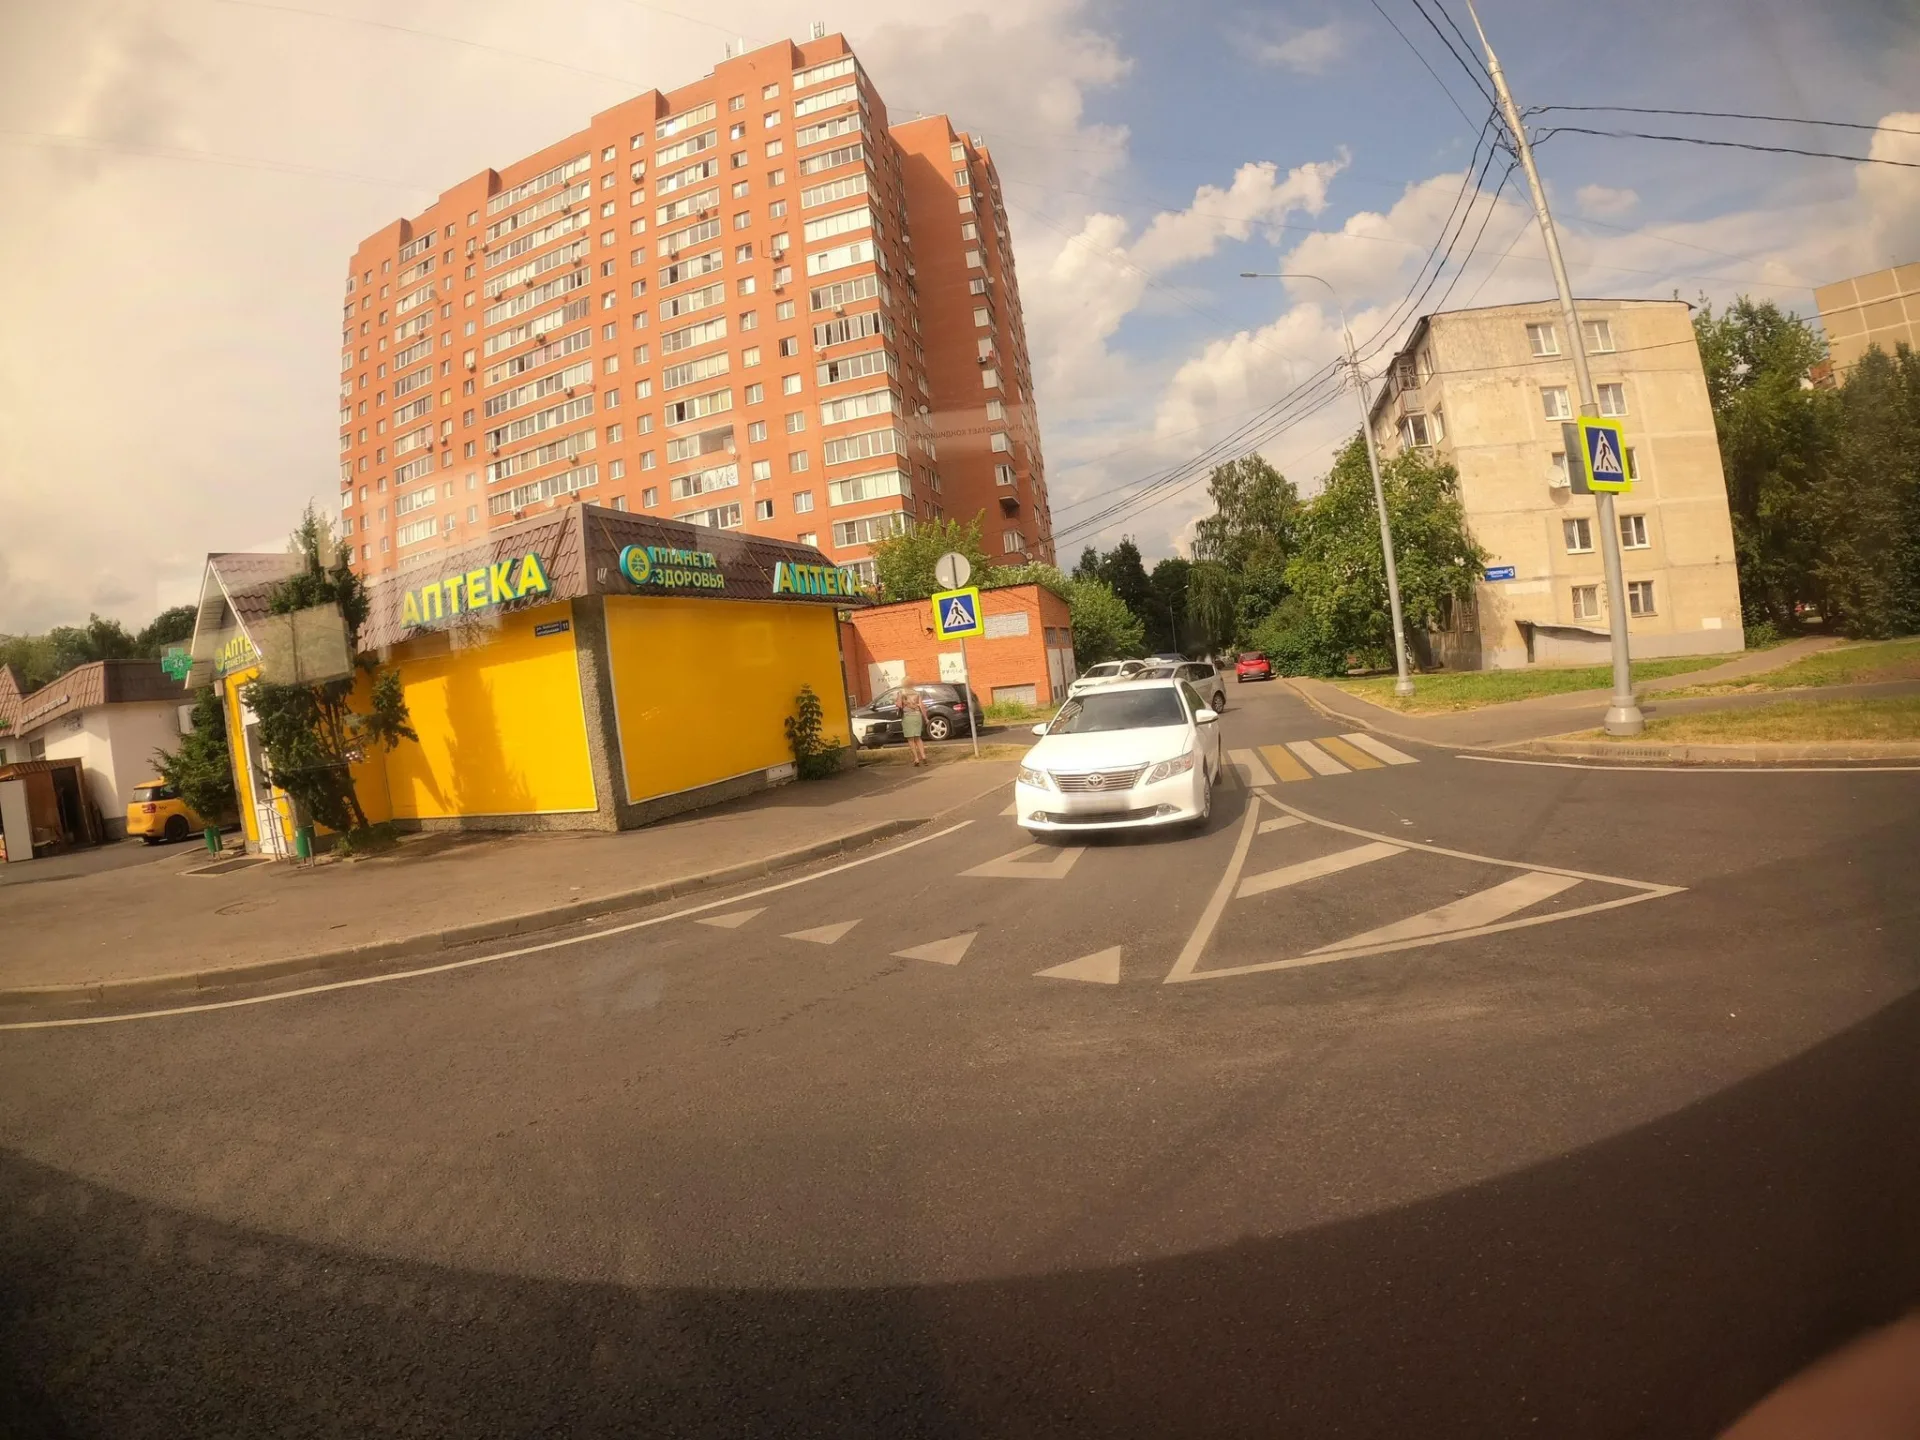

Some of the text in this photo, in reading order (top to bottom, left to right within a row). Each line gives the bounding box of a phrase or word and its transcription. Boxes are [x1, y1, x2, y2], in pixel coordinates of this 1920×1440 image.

[650, 546, 717, 568] ПЛАНЕТА
[655, 568, 725, 588] ЗДОРОВЬЯ
[774, 562, 864, 597] АПТЕКА
[1508, 568, 1514, 576] 3
[400, 552, 549, 629] АПТЕКА
